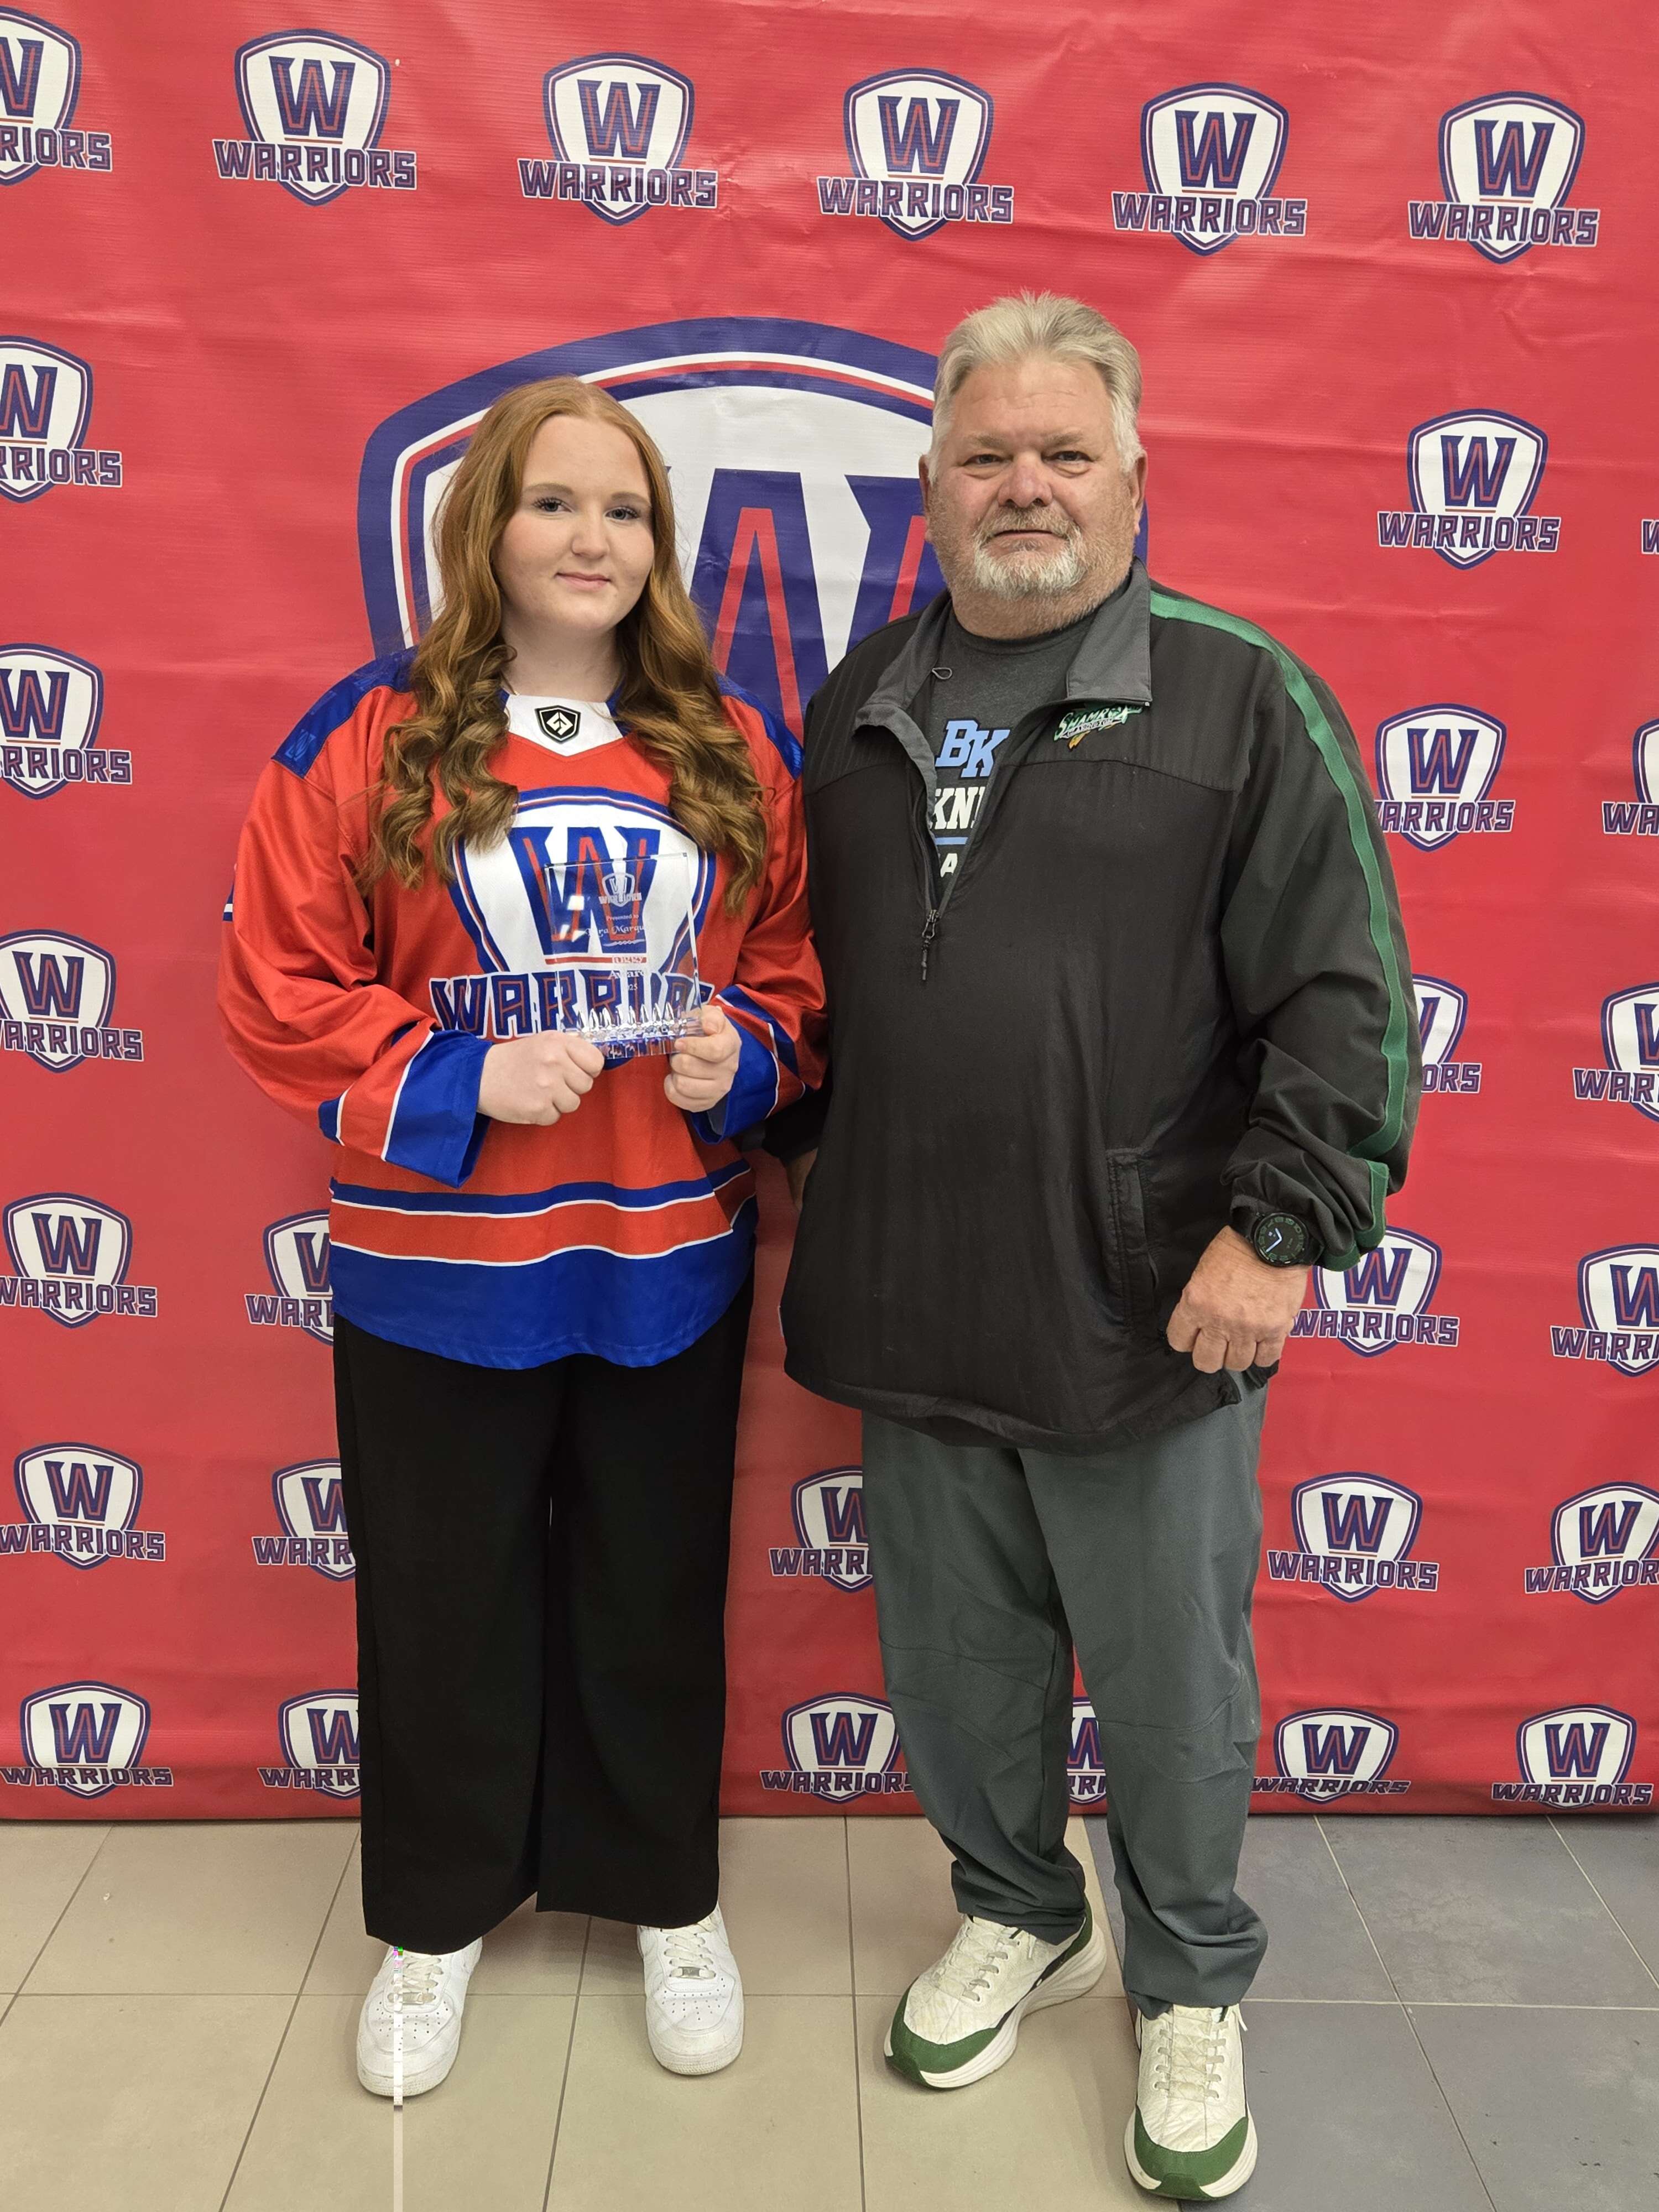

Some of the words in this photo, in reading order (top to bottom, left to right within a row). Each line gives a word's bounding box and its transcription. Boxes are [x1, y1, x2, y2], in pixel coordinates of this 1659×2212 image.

[269, 56, 355, 137] W
[577, 80, 661, 158] W
[878, 96, 960, 175] W
[1175, 109, 1257, 189] W
[1474, 119, 1554, 197] W
[215, 140, 415, 189] WARRIORS
[519, 160, 717, 206] WARRIORS
[818, 178, 1013, 222] WARRIORS
[1112, 193, 1306, 234] WARRIORS
[1410, 202, 1598, 246] WARRIORS
[0, 449, 122, 486] RIORS
[1441, 435, 1517, 508] W
[1380, 513, 1559, 551] WARRIORS
[935, 720, 1010, 778] BK
[1407, 728, 1479, 794] W
[1378, 801, 1514, 832] ARRIORS
[13, 951, 85, 1016] W
[31, 1213, 102, 1275] W
[1292, 1310, 1459, 1346] WARRIORS
[44, 1460, 114, 1521] W
[0, 1525, 165, 1560] WARRIORS
[1321, 1492, 1394, 1552] W
[1579, 1501, 1643, 1557] W
[1269, 1552, 1438, 1590] WARRIORS
[1526, 1561, 1659, 1592] WARRIOR
[49, 1704, 122, 1763] W
[810, 1713, 878, 1766] W
[1302, 1724, 1371, 1775] W
[1545, 1723, 1610, 1777] W
[1, 1768, 173, 1786] WARRIORS
[1253, 1778, 1410, 1793] WARRIORS
[1493, 1785, 1653, 1804] WARRIORS
